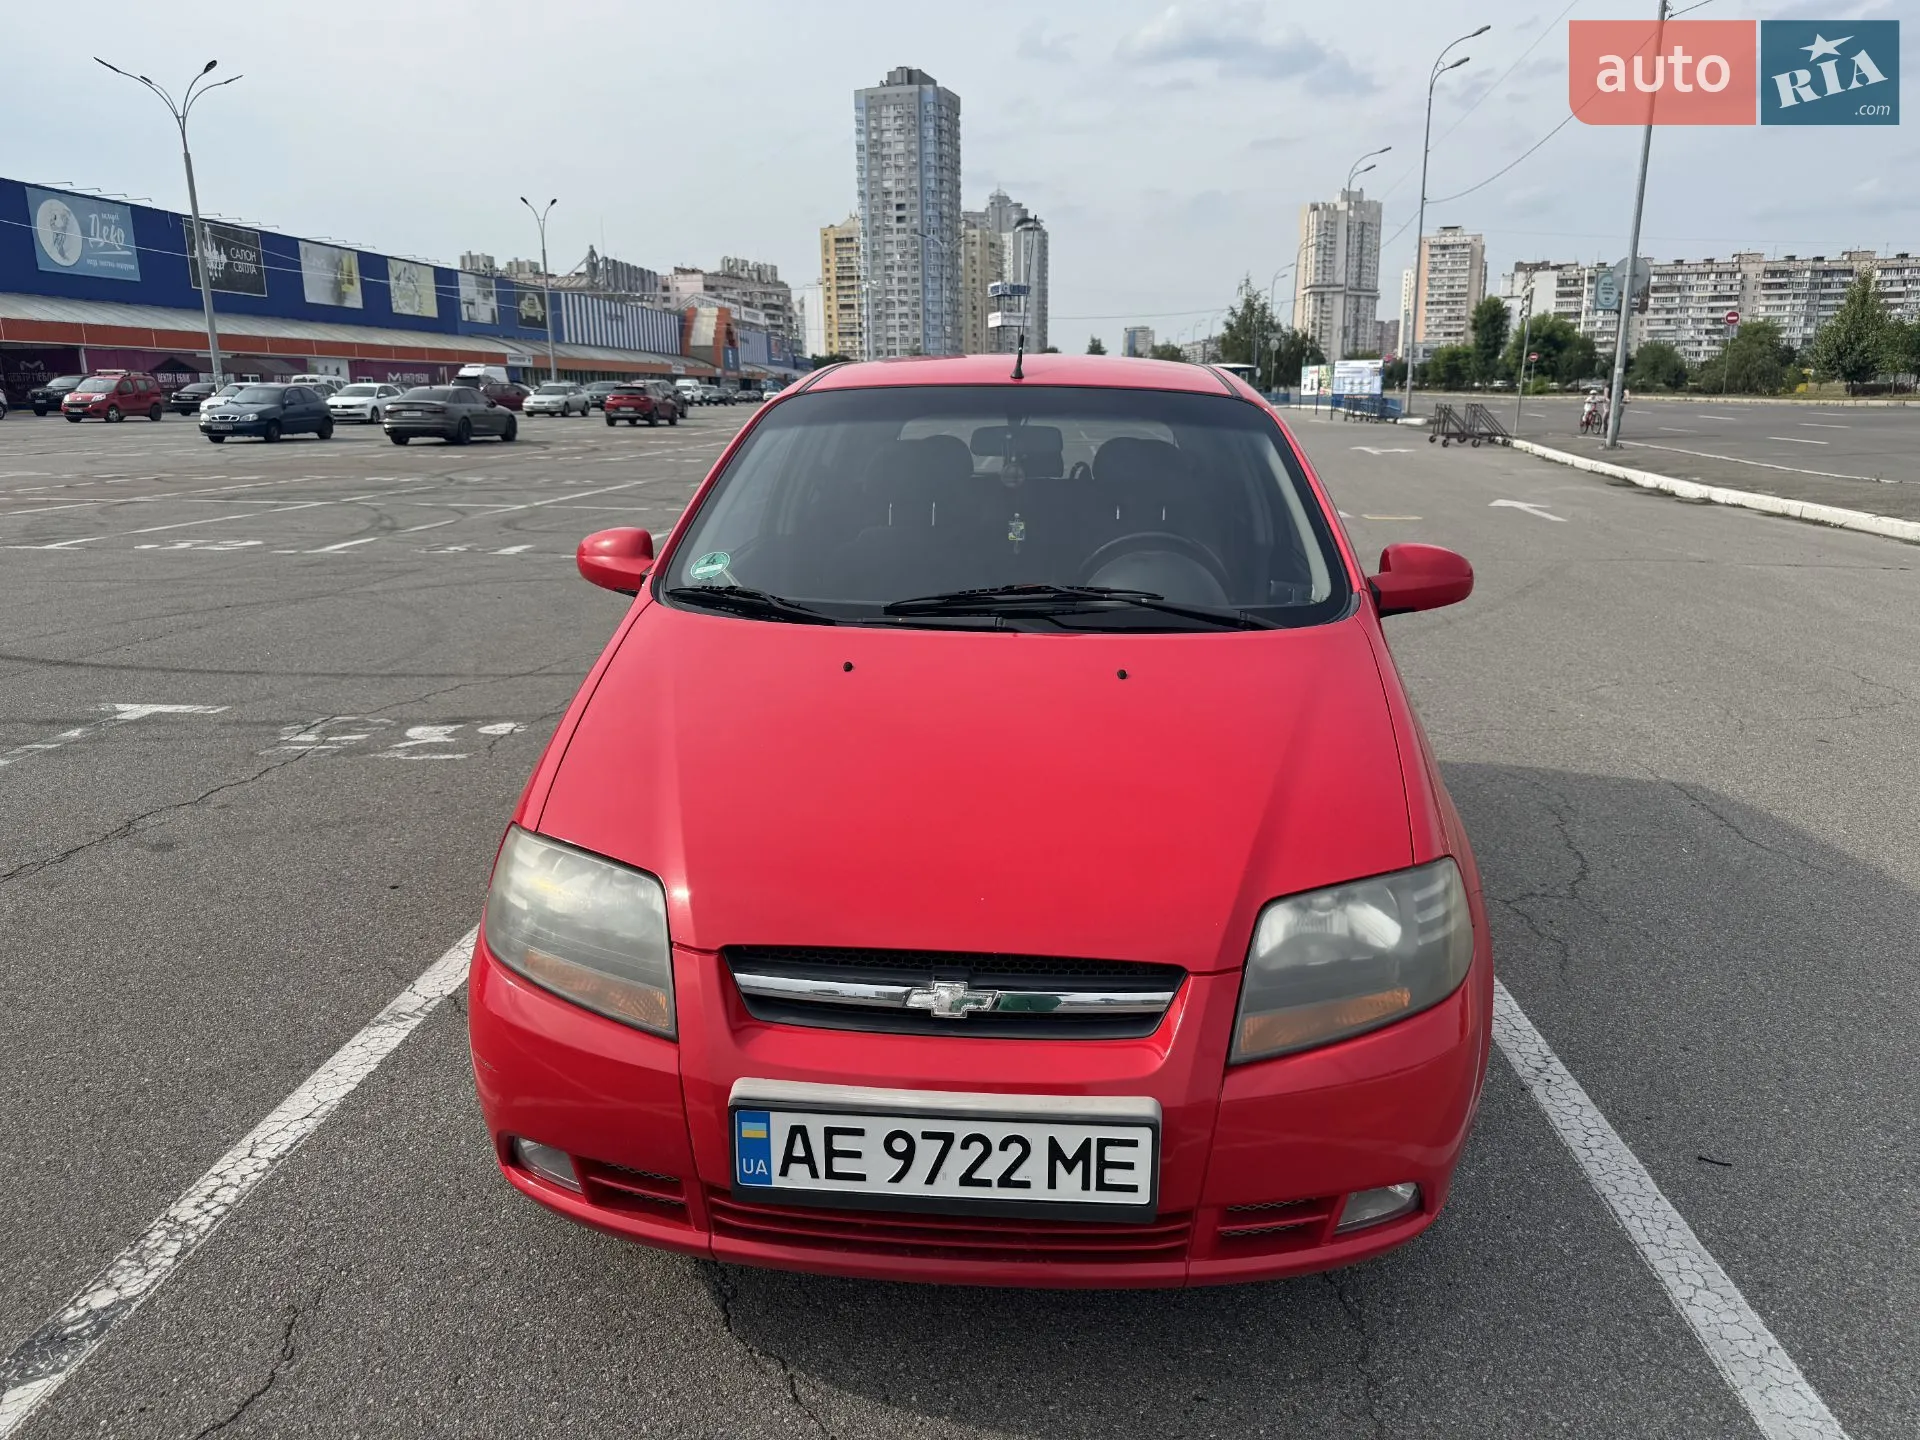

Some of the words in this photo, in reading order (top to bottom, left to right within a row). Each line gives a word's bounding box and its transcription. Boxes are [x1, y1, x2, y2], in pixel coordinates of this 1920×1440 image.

[230, 247, 257, 262] САЛОН
[742, 1158, 769, 1176] UA
[778, 1124, 867, 1182] AE
[883, 1129, 1032, 1189] 9722
[1047, 1135, 1139, 1193] ME
